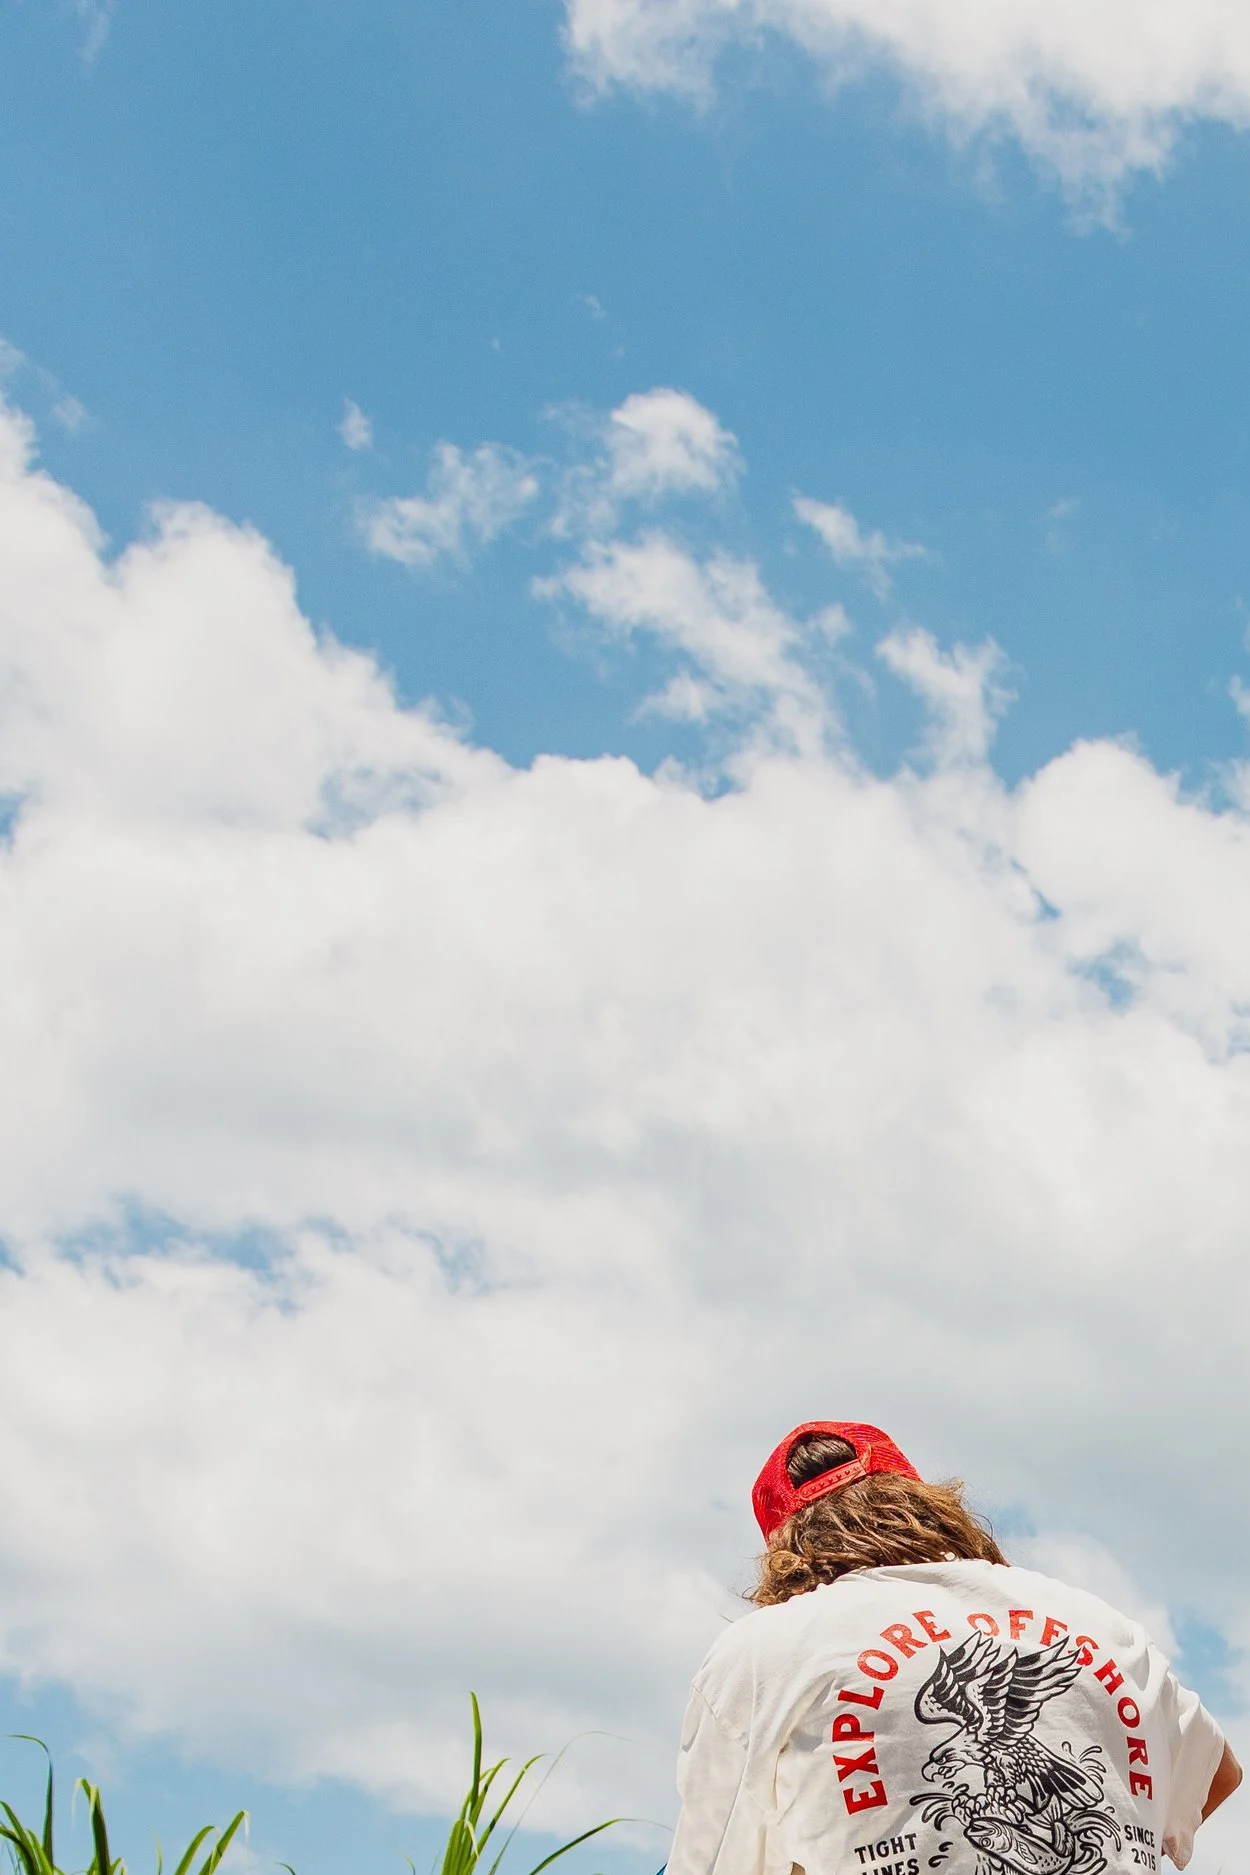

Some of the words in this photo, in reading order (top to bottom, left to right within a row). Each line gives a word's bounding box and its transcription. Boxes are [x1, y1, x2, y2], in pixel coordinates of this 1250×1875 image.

[832, 1610, 951, 1816] EXPLORE
[967, 1610, 1153, 1800] OFFSHORE
[854, 1833, 917, 1864] TIGHT
[1124, 1825, 1155, 1848] SINCE
[1131, 1848, 1156, 1871] 2015
